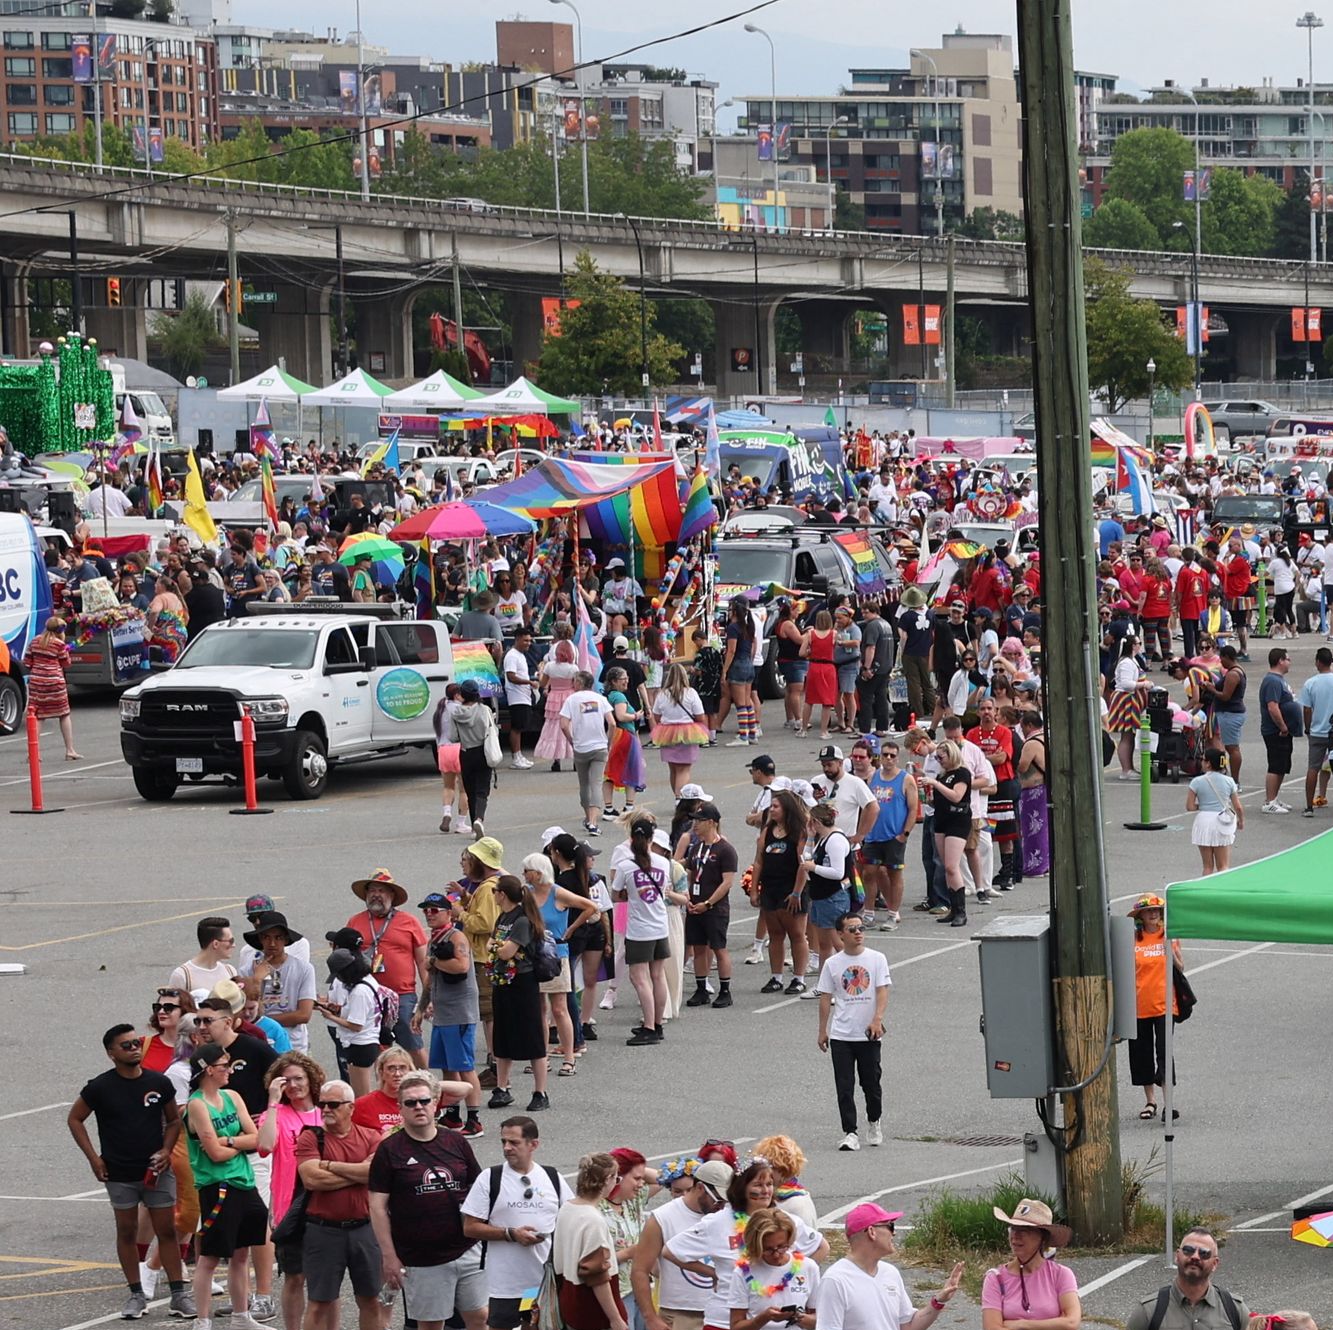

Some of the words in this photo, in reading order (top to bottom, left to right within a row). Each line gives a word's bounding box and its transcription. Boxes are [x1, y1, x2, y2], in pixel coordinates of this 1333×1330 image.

[123, 655, 141, 667] CUPE
[167, 704, 208, 712] RAM
[647, 889, 655, 901] 2
[1134, 945, 1155, 953] David
[378, 1113, 401, 1121] RICHM
[507, 1201, 544, 1210] MOSAIC
